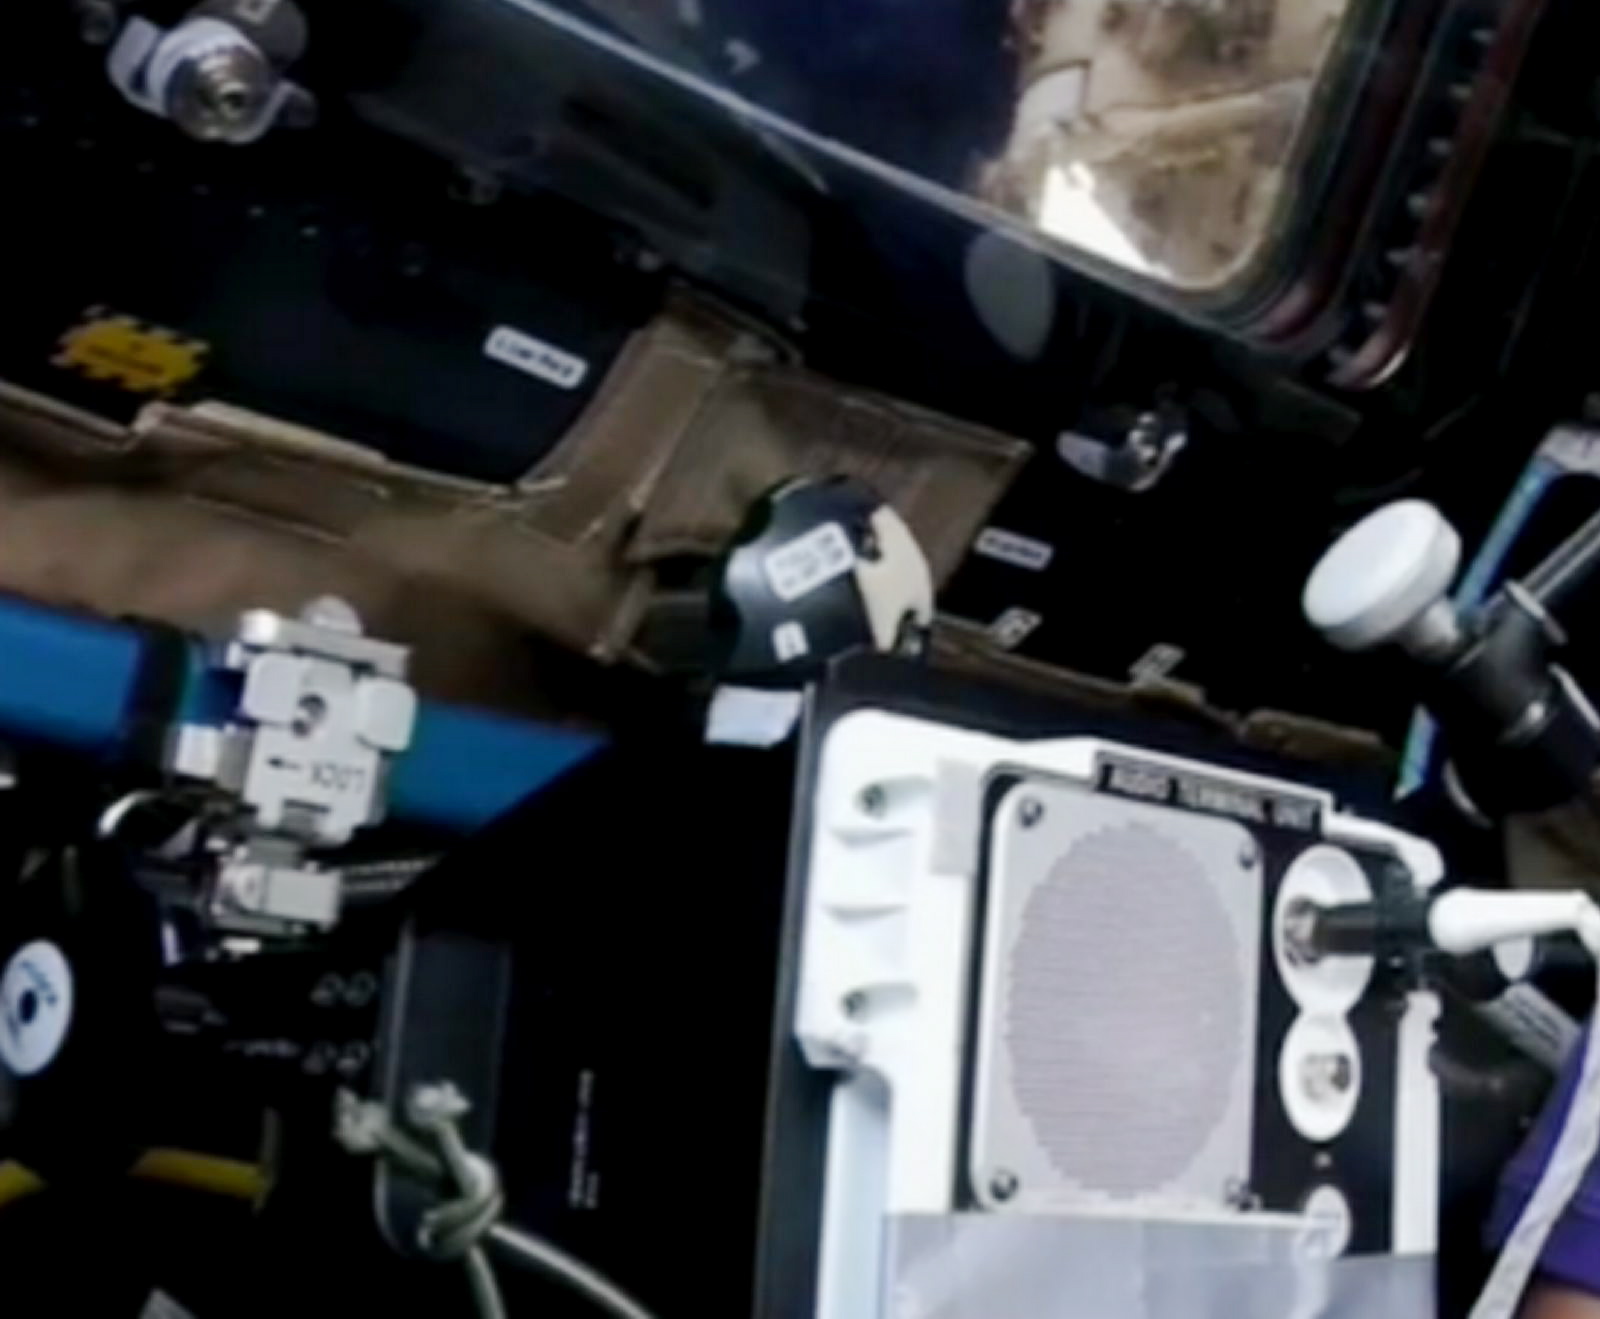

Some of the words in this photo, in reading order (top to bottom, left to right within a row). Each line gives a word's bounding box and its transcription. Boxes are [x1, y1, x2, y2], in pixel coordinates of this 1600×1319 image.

[311, 761, 366, 793] LOCK
[1110, 763, 1168, 801] AUDIO
[1177, 777, 1262, 823] TERMINAL
[1273, 799, 1313, 829] UNIT
